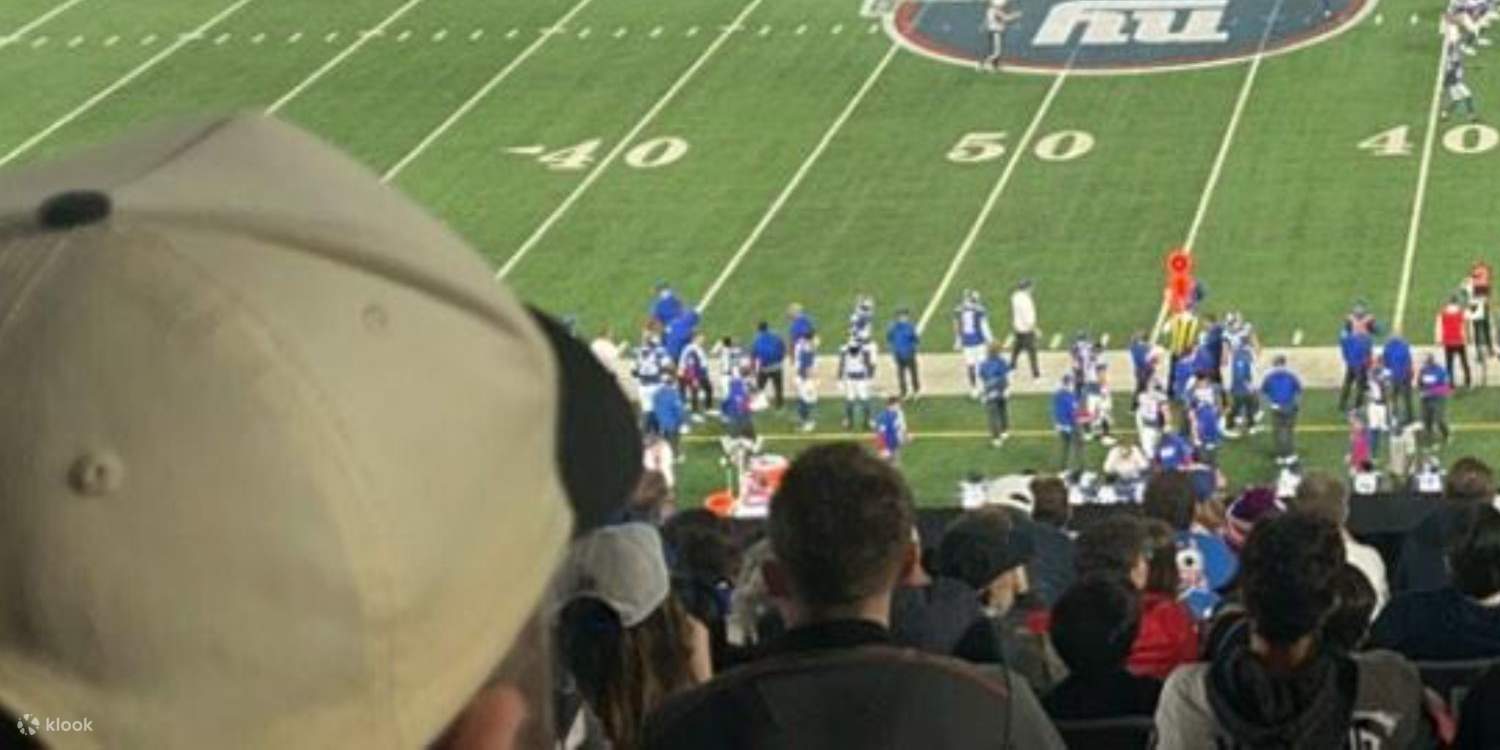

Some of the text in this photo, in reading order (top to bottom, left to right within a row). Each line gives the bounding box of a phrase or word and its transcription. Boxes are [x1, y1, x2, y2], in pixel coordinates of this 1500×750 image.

[537, 137, 688, 169] 40
[946, 131, 1094, 162] 50
[1358, 124, 1499, 156] 40
